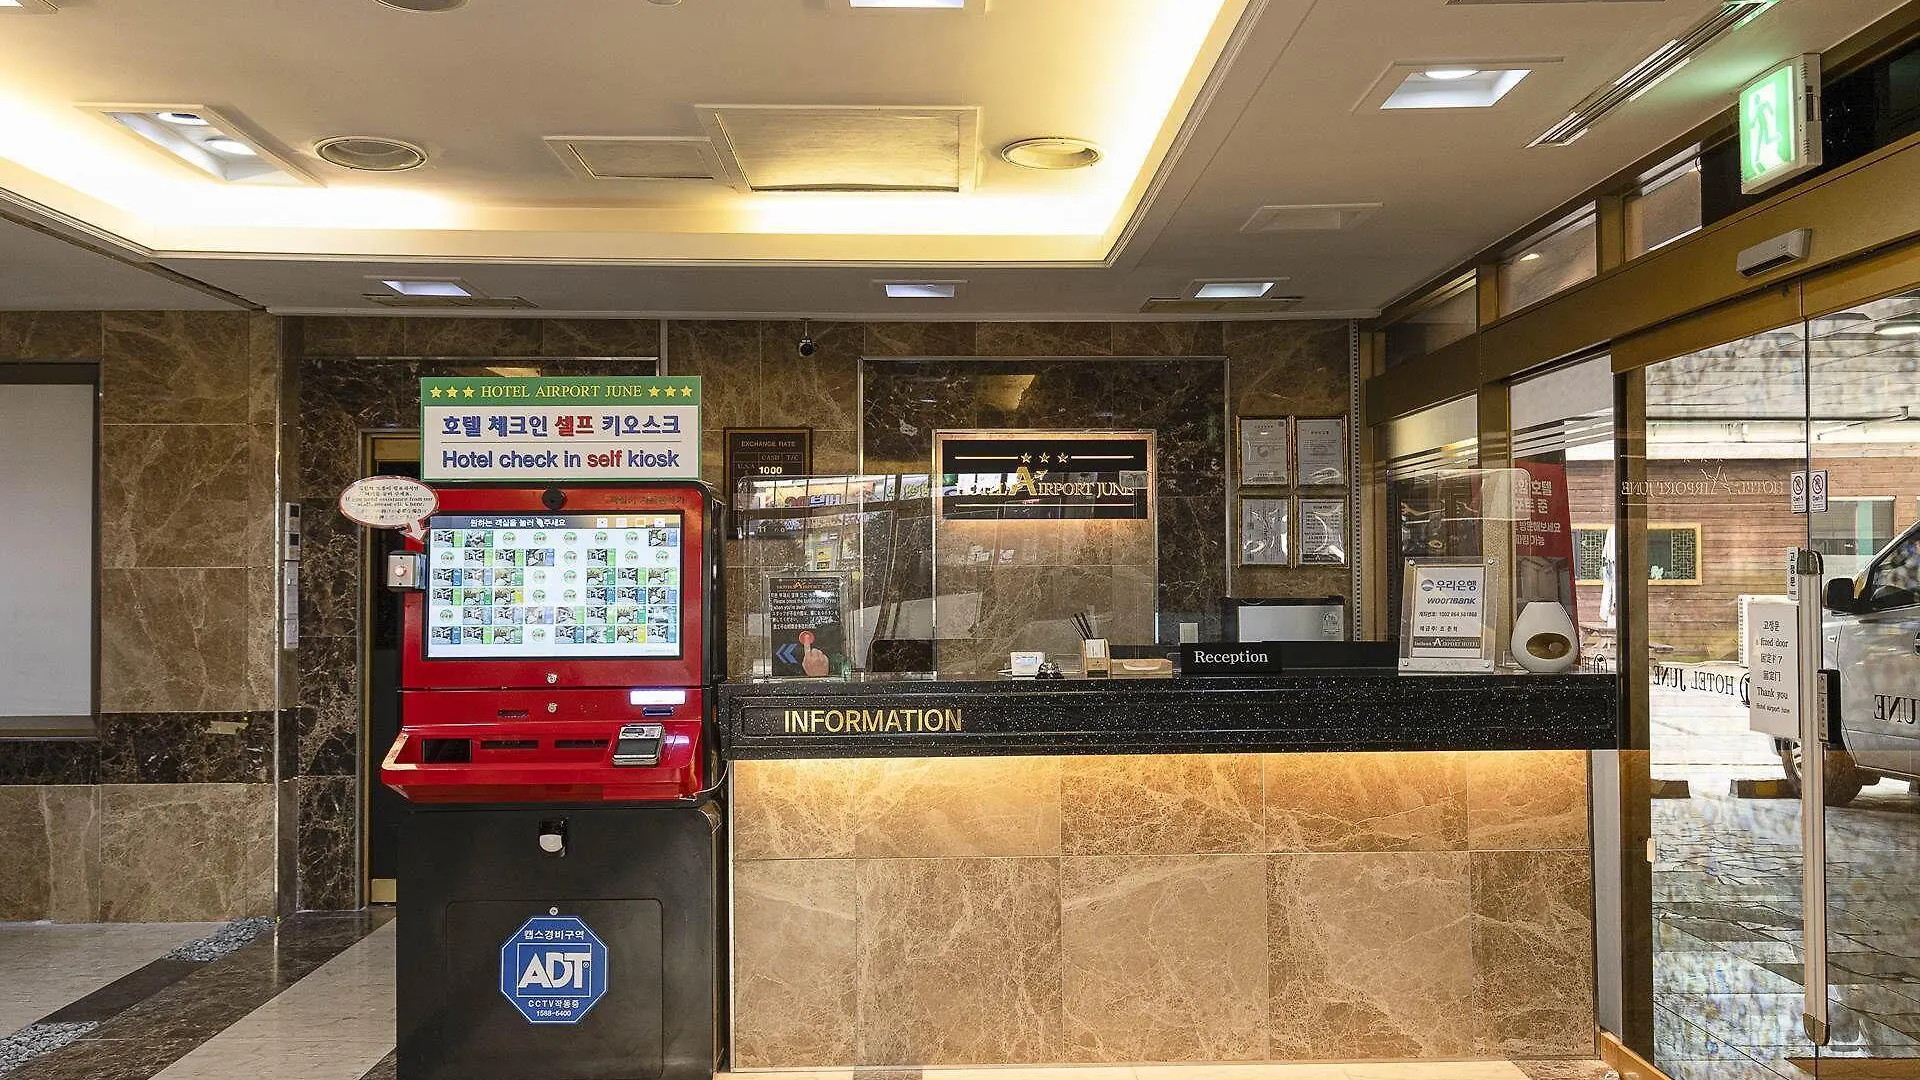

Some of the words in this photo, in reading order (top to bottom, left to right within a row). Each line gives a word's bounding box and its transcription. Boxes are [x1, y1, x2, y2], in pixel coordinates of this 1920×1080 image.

[480, 385, 530, 398] HOTEL
[535, 385, 601, 398] AIRPORT
[605, 385, 642, 398] JUNE
[442, 415, 482, 437] 호텔
[488, 415, 547, 437] 체크인
[554, 415, 595, 437] 셀프
[602, 415, 681, 437] 키오스크
[741, 440, 777, 448] EXCHANGE
[779, 440, 796, 448] RATE
[442, 450, 494, 468] Hotel
[499, 450, 558, 468] check
[564, 450, 582, 468] in
[587, 450, 622, 468] self
[628, 450, 680, 468] kiosk
[758, 466, 783, 475] 1000
[1095, 482, 1135, 498] JUNE
[1436, 580, 1477, 591] 우리은행
[1775, 638, 1789, 648] door
[1194, 650, 1268, 665] Reception
[1756, 686, 1775, 698] Thank
[1777, 691, 1788, 700] you
[783, 708, 963, 734] INFORMATION
[524, 930, 585, 940] 캡스경비구역
[518, 952, 591, 988] ADT
